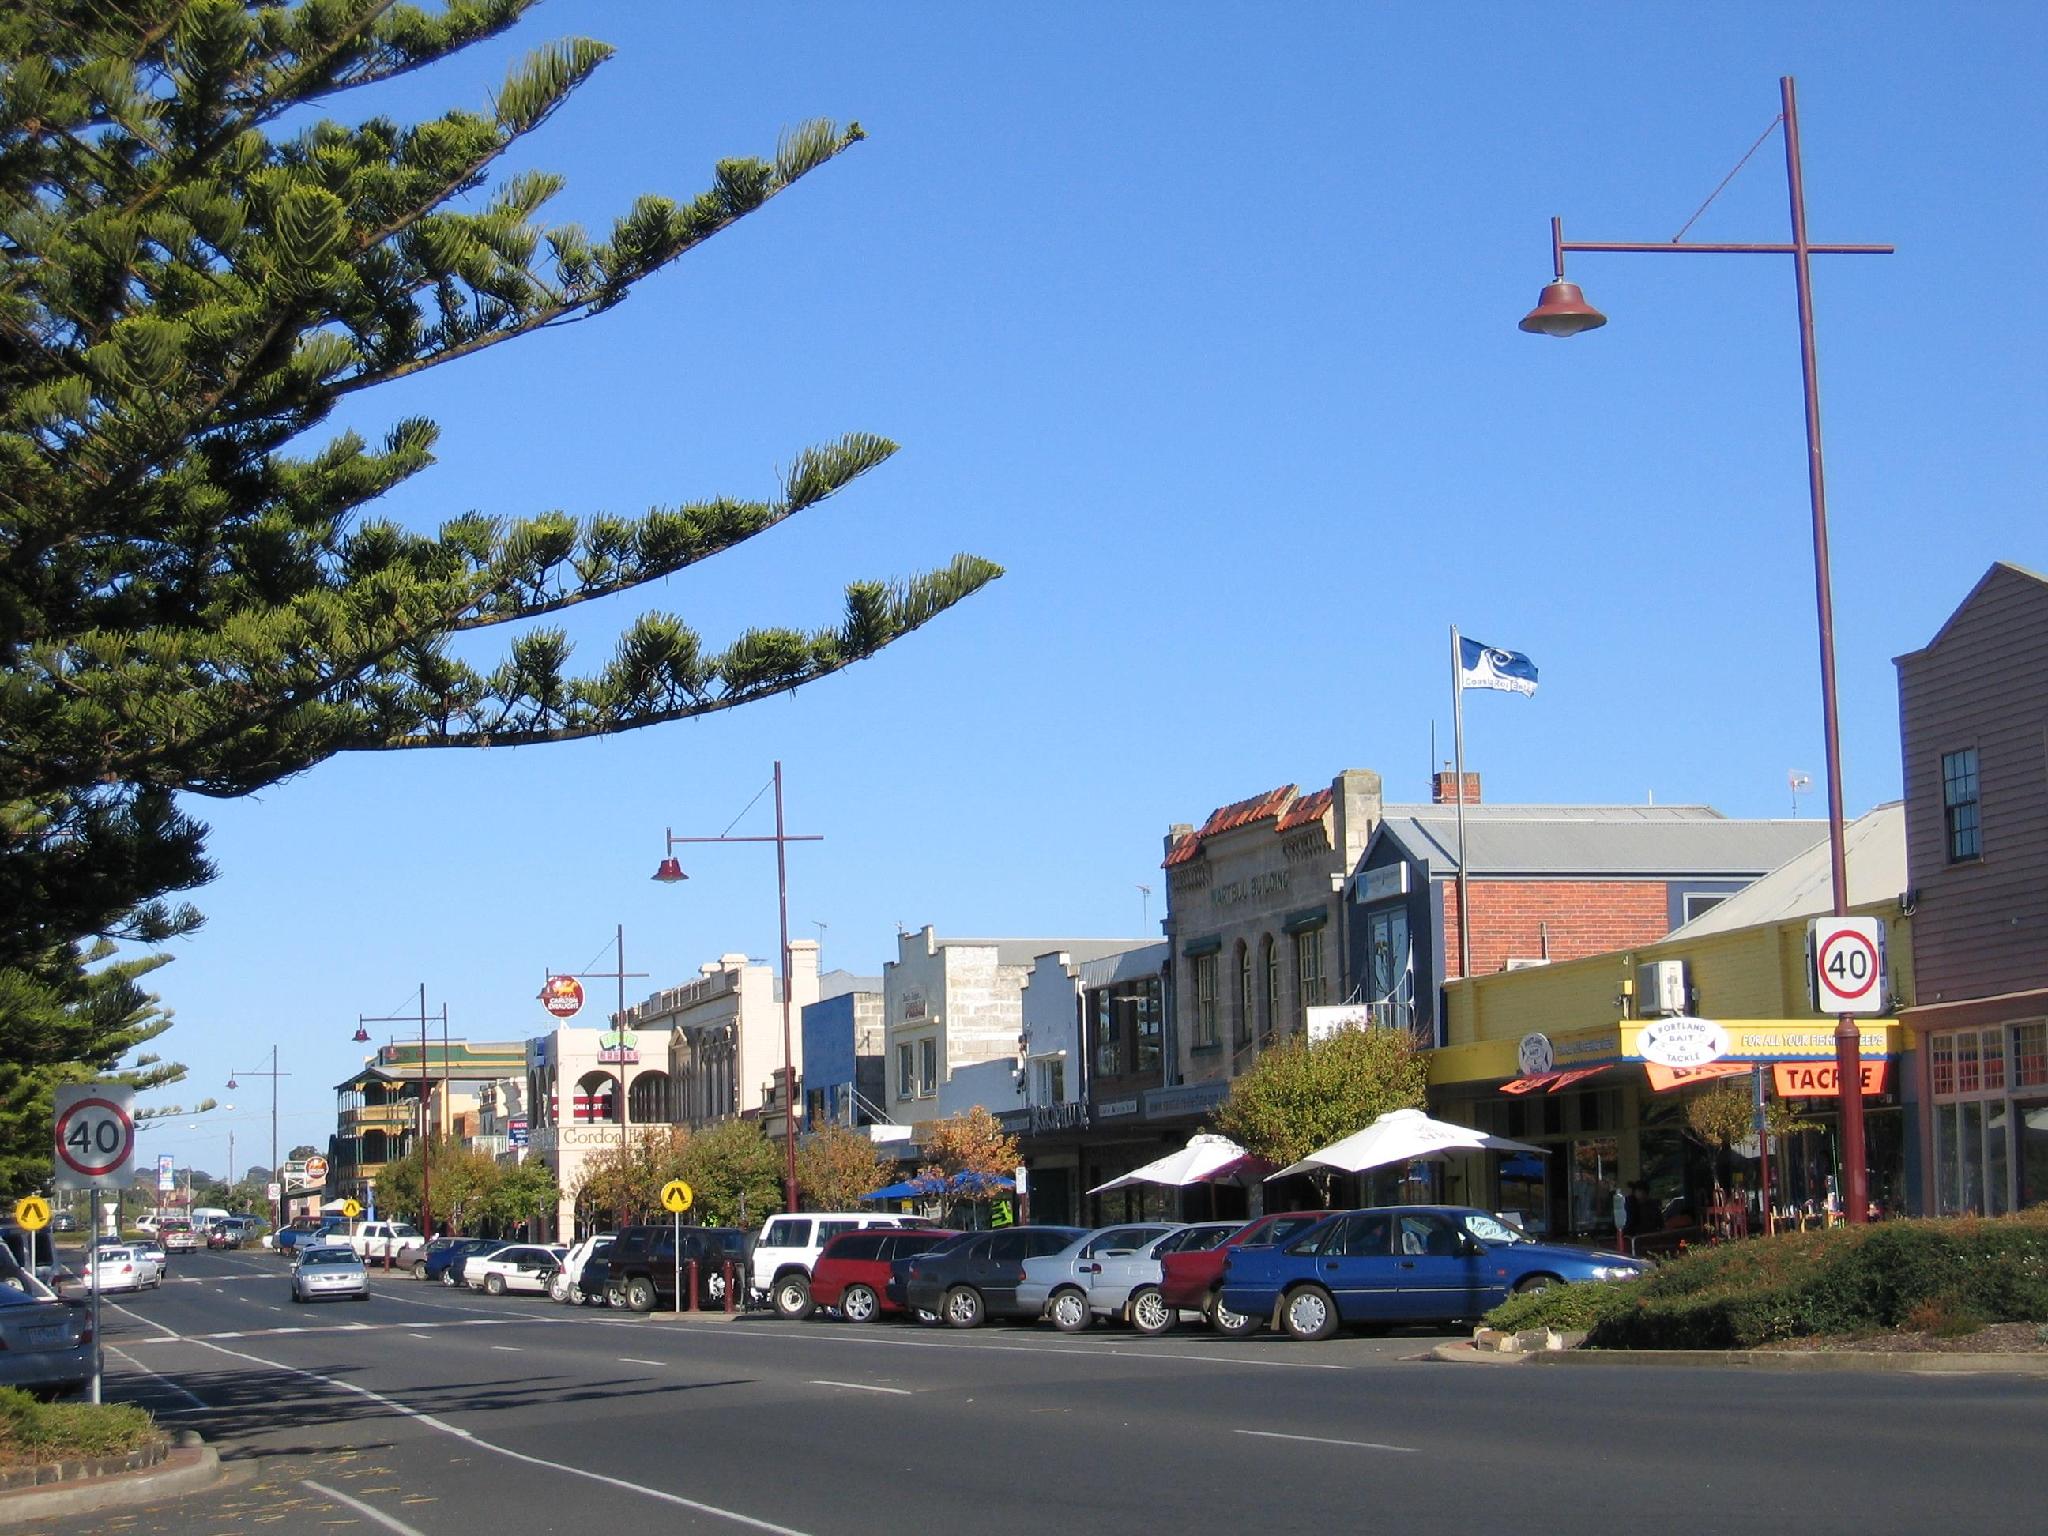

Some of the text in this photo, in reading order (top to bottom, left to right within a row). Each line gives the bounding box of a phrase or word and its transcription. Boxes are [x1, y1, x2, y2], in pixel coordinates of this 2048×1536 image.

[1828, 950, 1867, 979] 40
[1658, 1022, 1706, 1034] PORTLAND
[1669, 1034, 1694, 1042] BAIT
[1742, 1034, 1884, 1047] FOR ALL YOUR FISHI EEDS
[1667, 1052, 1700, 1062] TACKLE
[1786, 1067, 1873, 1089] TACE
[67, 1119, 120, 1154] 40
[563, 1127, 622, 1144] Gordon
